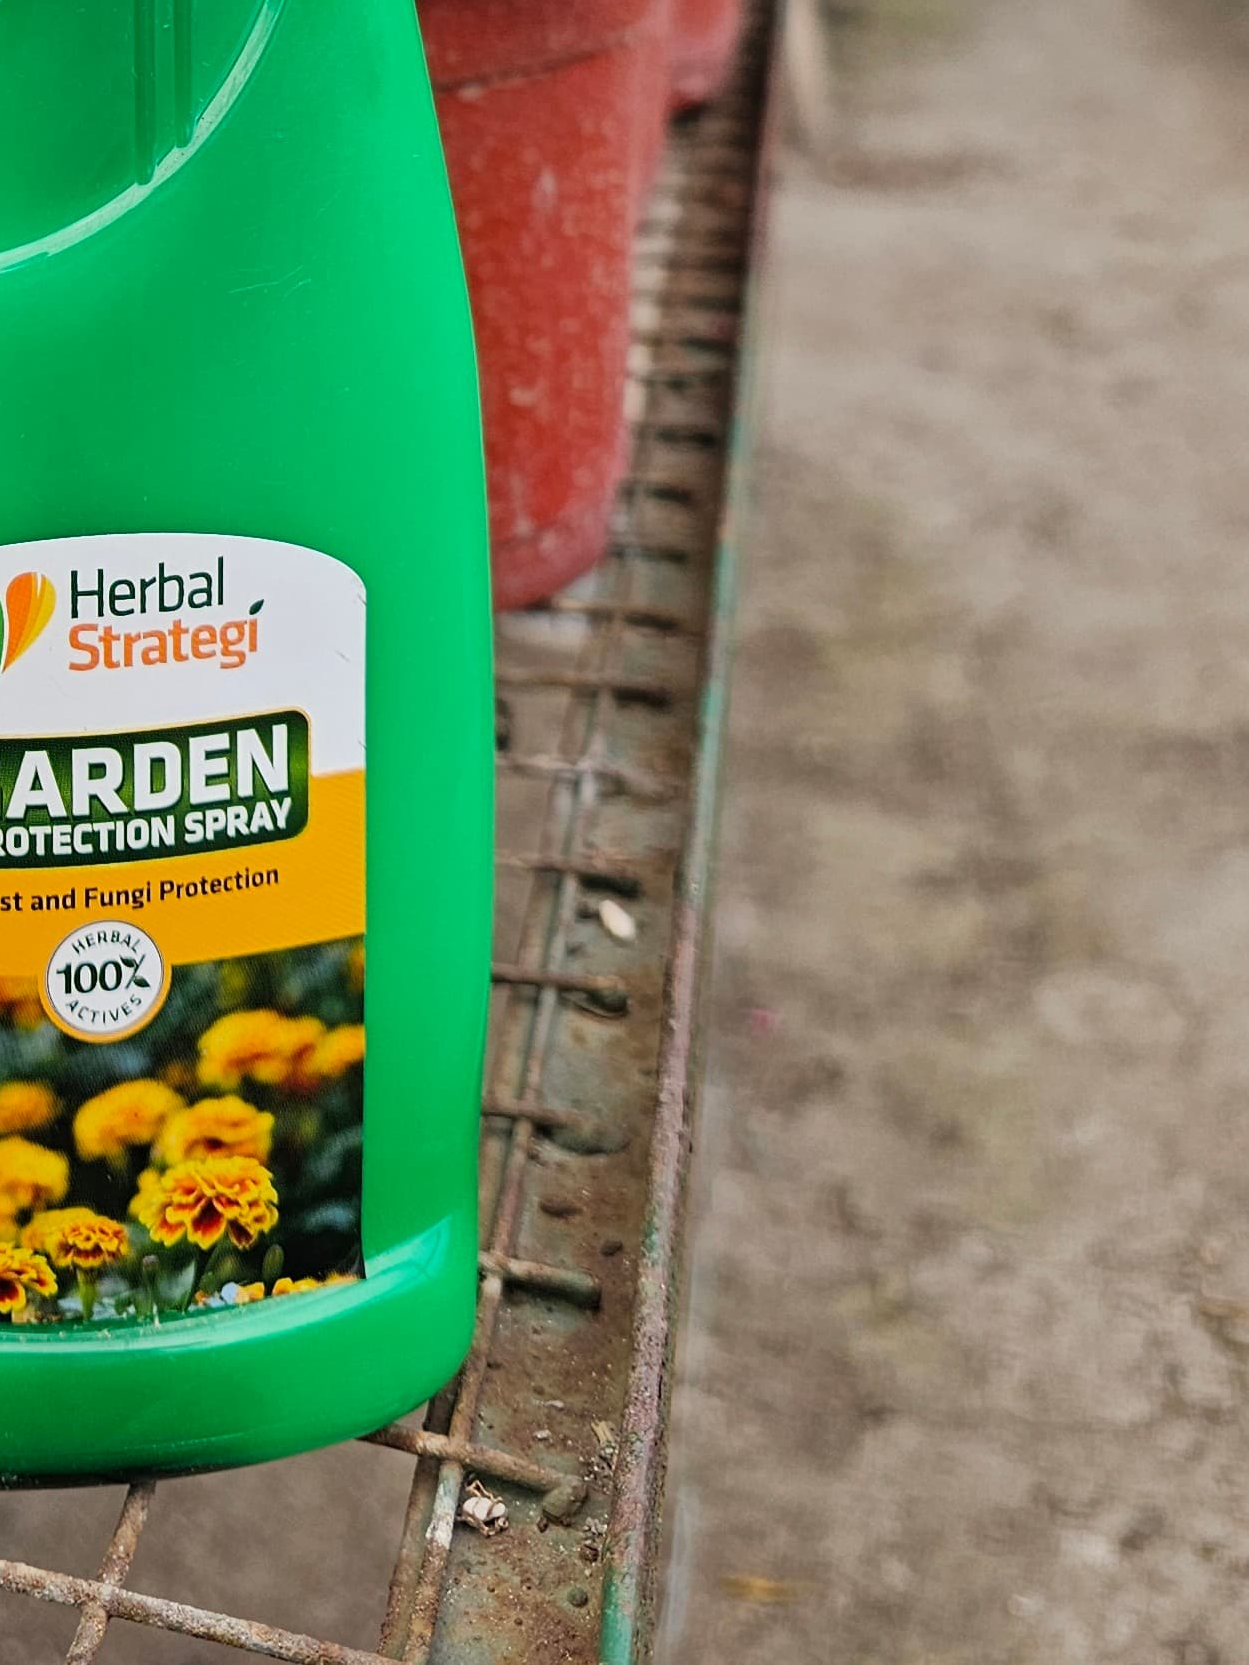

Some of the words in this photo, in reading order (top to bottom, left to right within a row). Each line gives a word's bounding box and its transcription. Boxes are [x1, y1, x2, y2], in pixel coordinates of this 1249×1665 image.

[70, 555, 224, 620] Herbal
[68, 599, 264, 672] Strategi
[184, 796, 293, 845] SPRAY
[30, 887, 76, 912] and
[84, 881, 152, 910] Fungi
[160, 867, 280, 901] Protection
[71, 930, 142, 956] HERBAL
[66, 993, 143, 1025] ACTIVES
